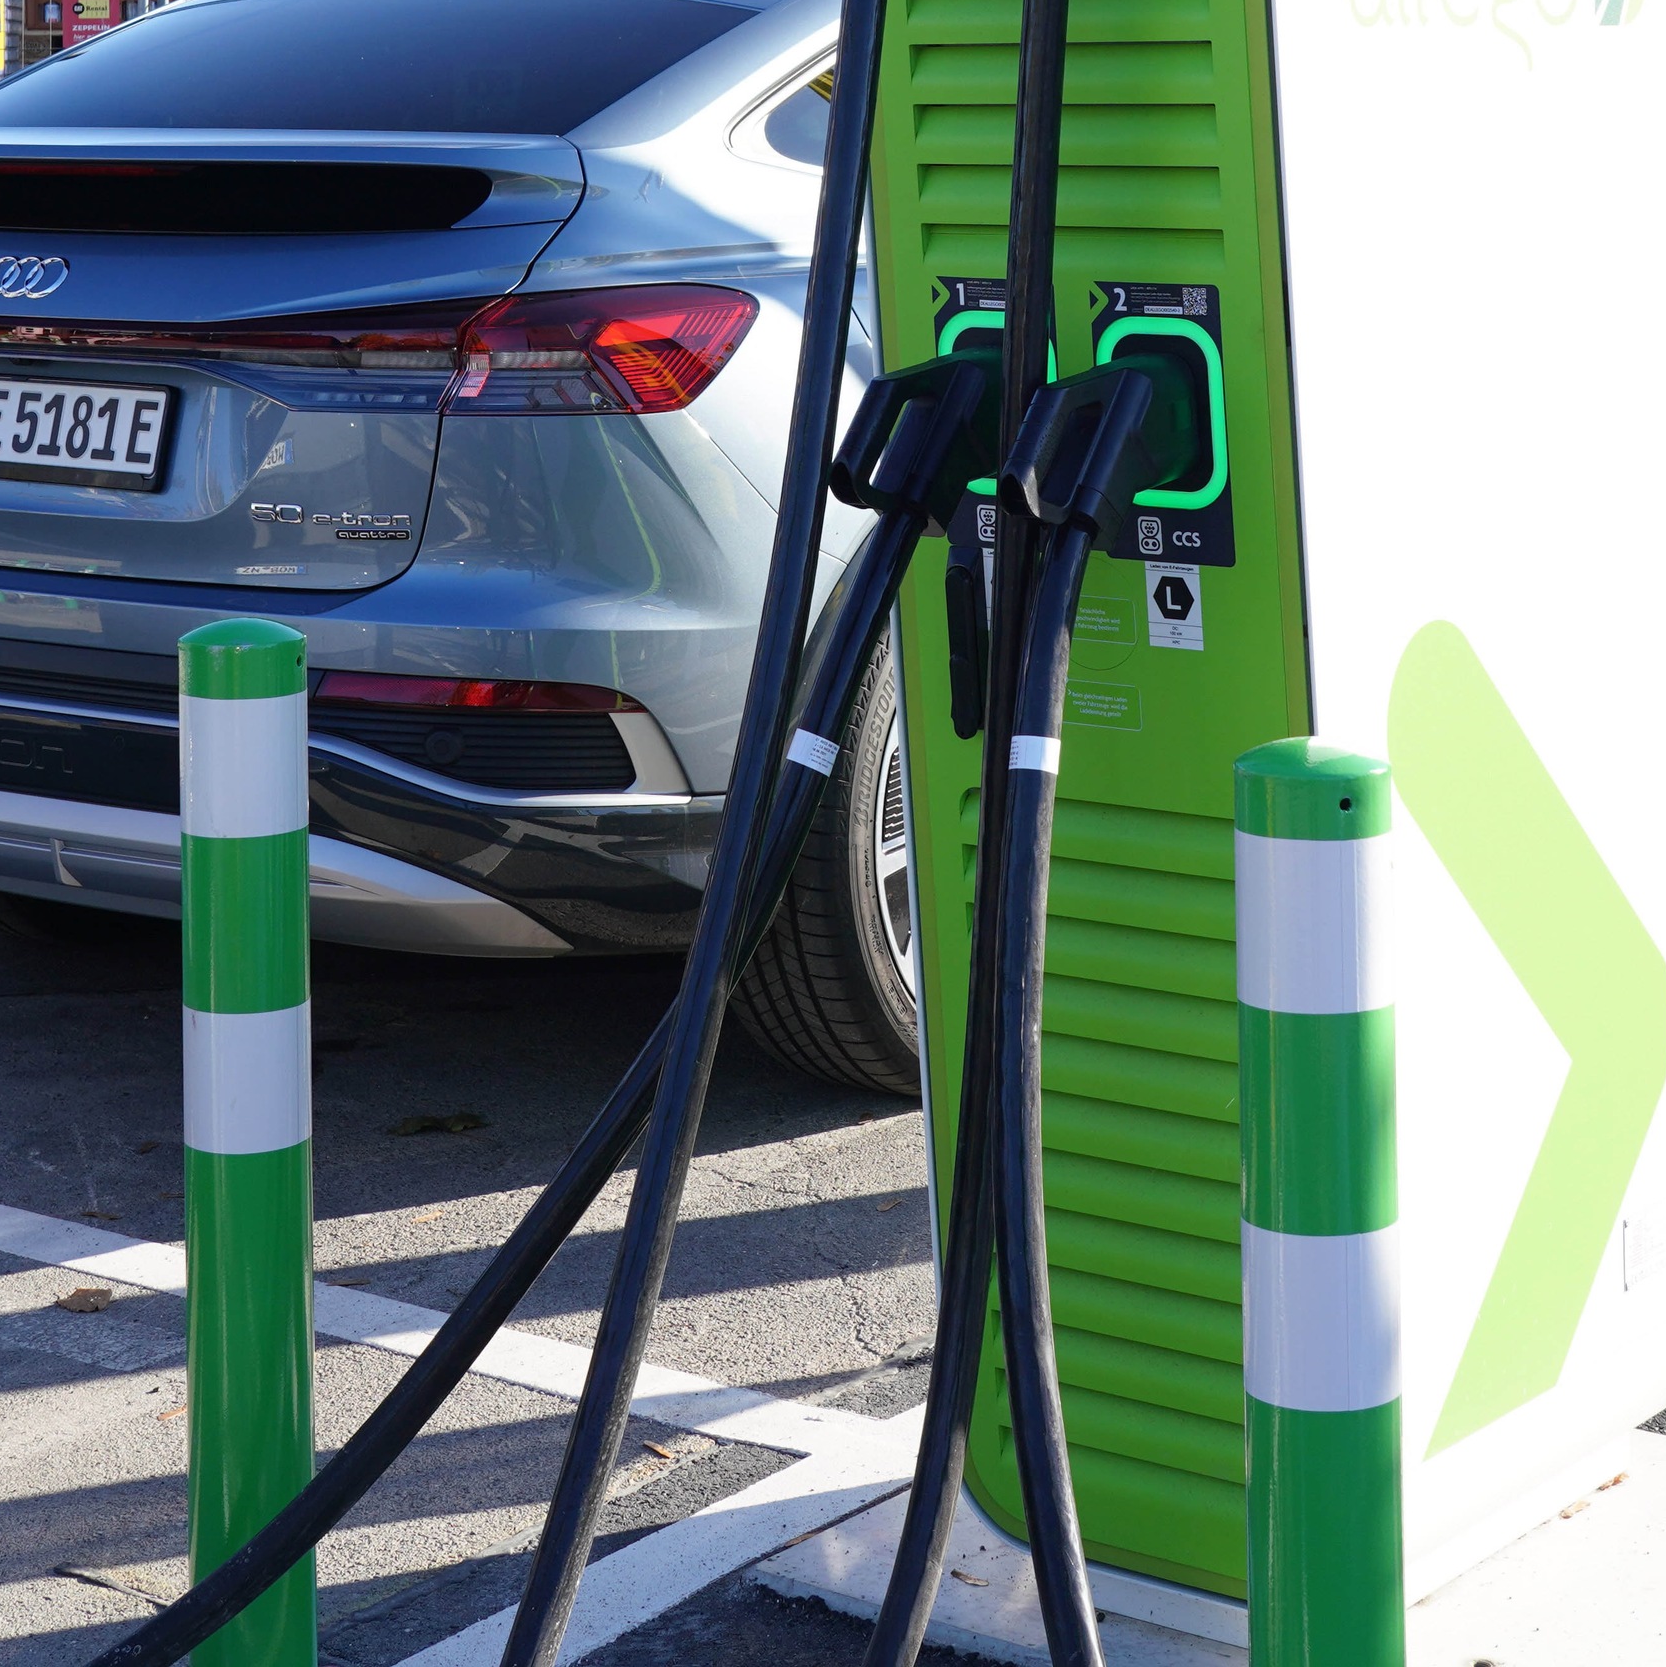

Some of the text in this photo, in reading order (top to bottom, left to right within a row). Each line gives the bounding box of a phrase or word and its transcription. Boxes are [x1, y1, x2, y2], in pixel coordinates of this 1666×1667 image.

[956, 282, 965, 306] 1
[1113, 287, 1127, 312] 2
[250, 501, 412, 526] 50 e-tron
[338, 531, 408, 540] quattro
[1172, 530, 1202, 548] CCS
[1165, 585, 1182, 611] L
